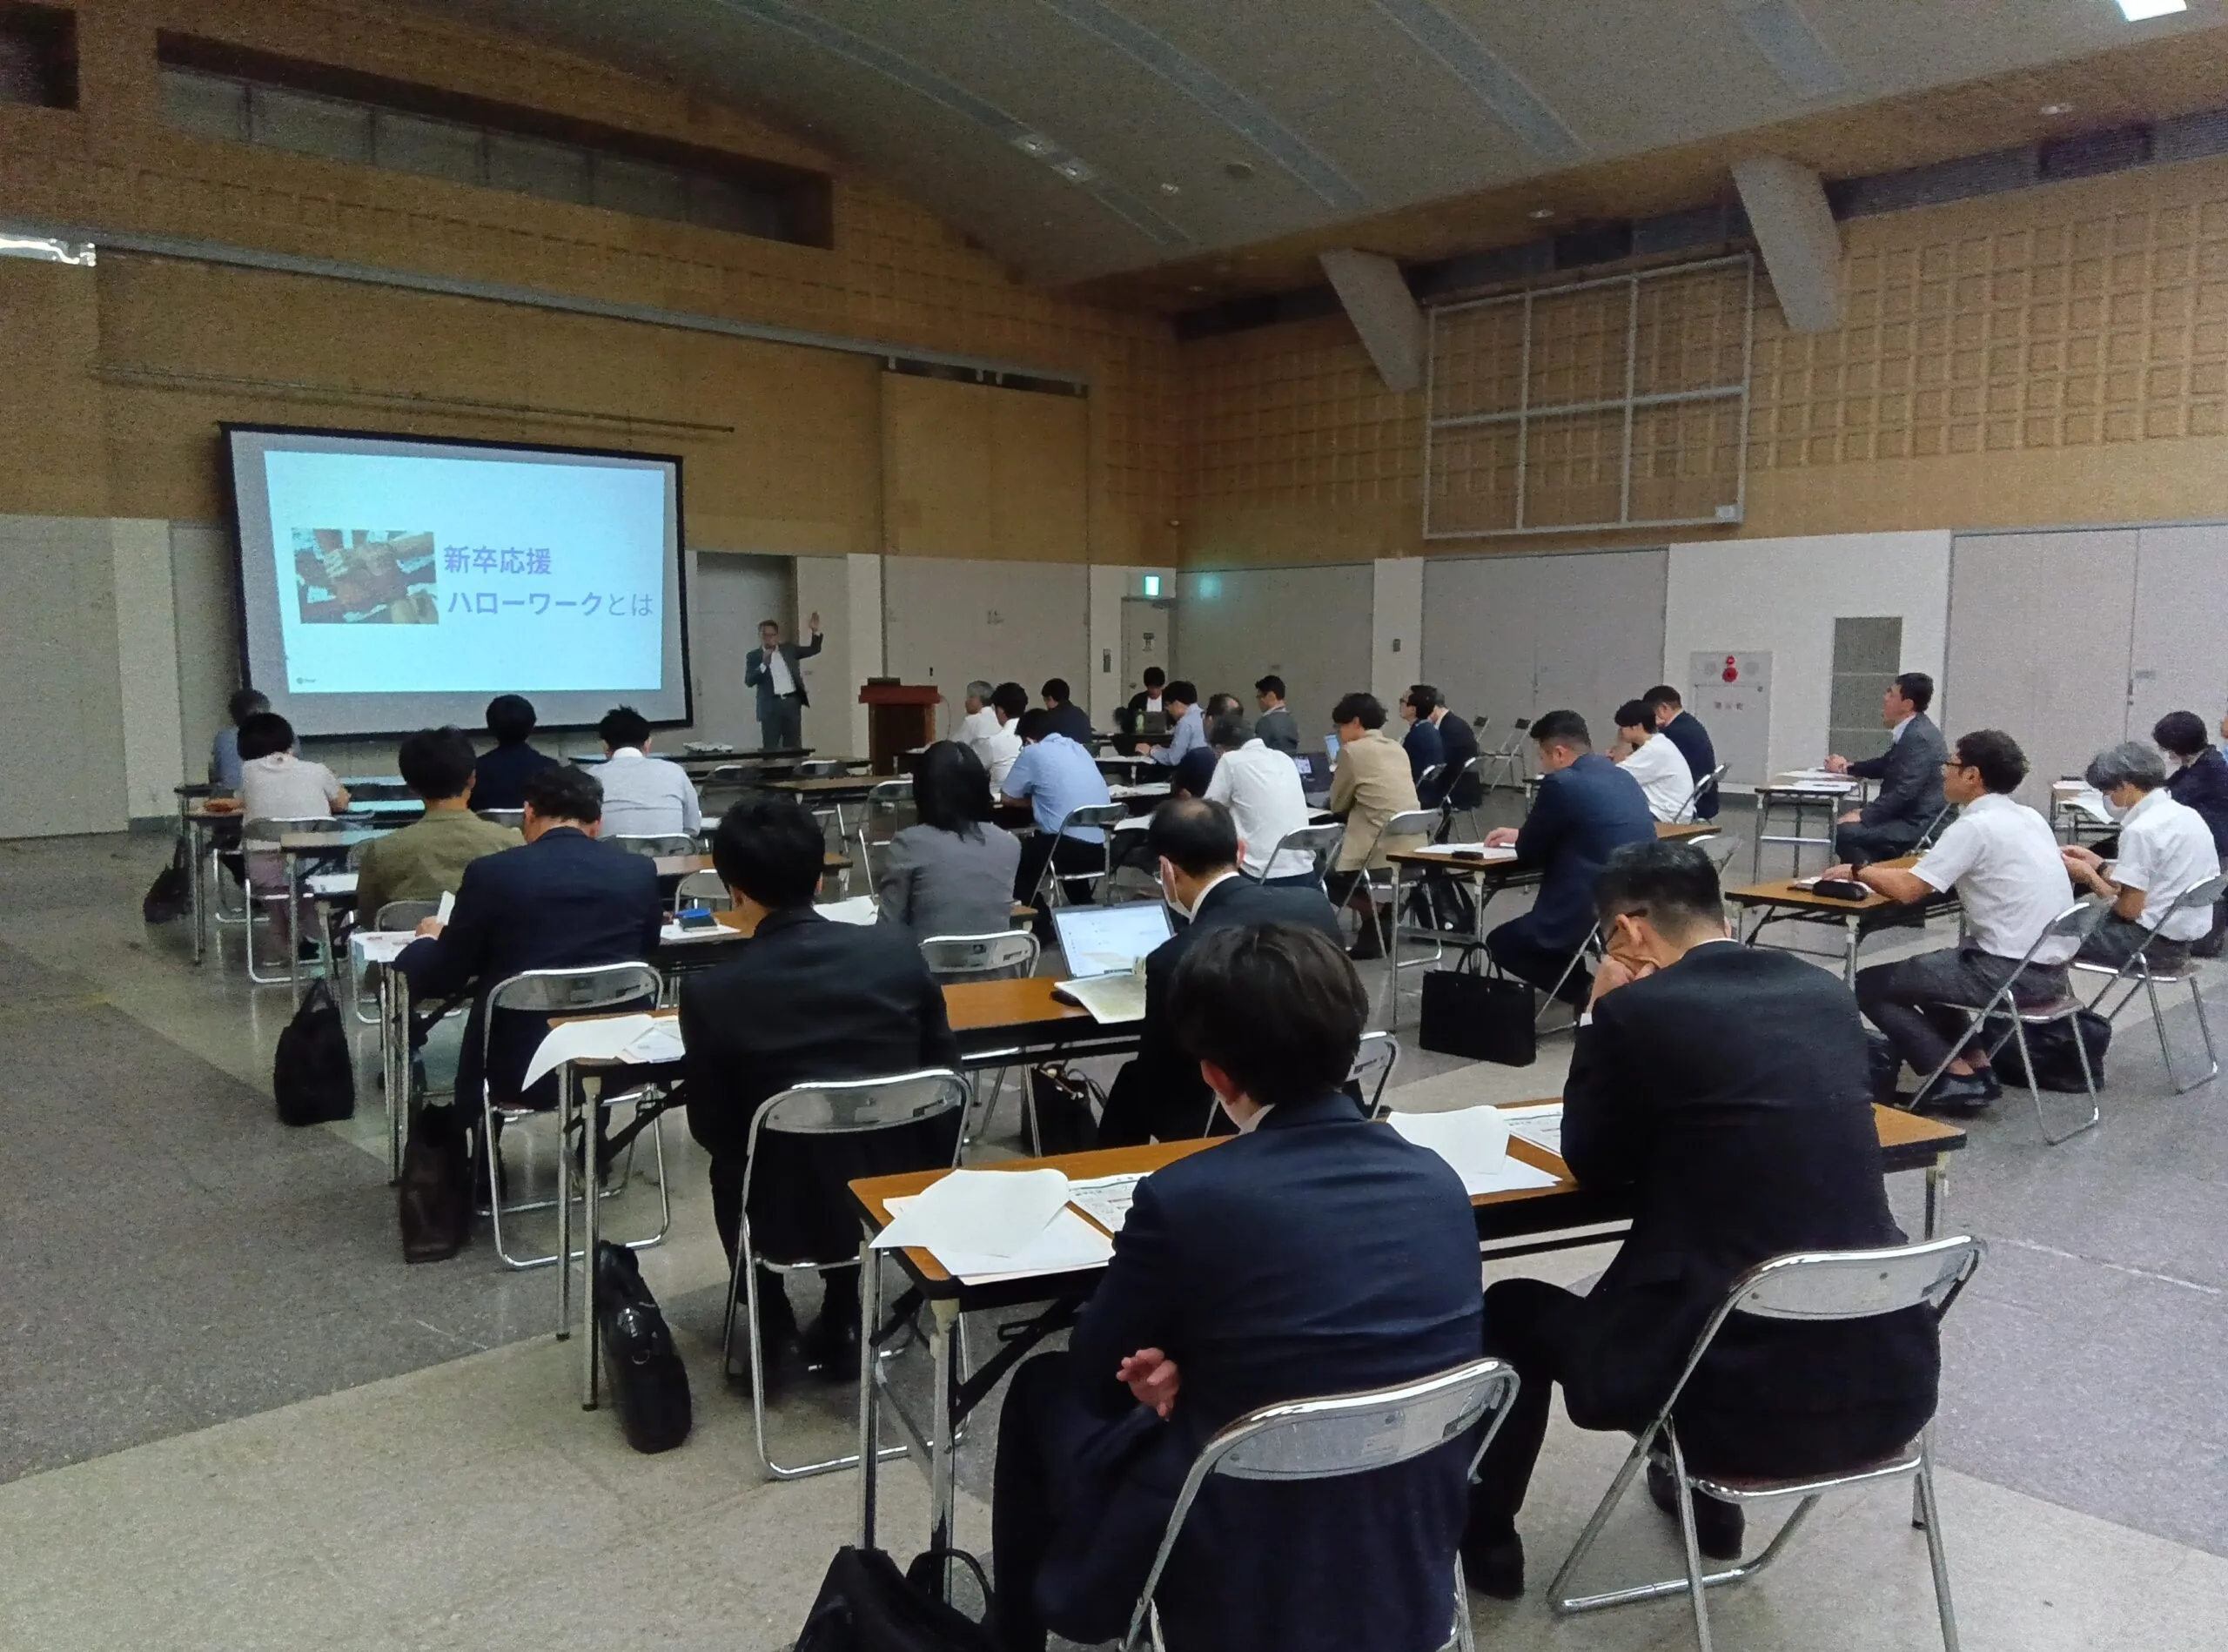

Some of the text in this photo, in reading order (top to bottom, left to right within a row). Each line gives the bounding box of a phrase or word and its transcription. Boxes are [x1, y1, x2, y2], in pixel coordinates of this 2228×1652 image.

[444, 545, 552, 574] 新卒応援
[447, 592, 654, 616] ハローワークとは
